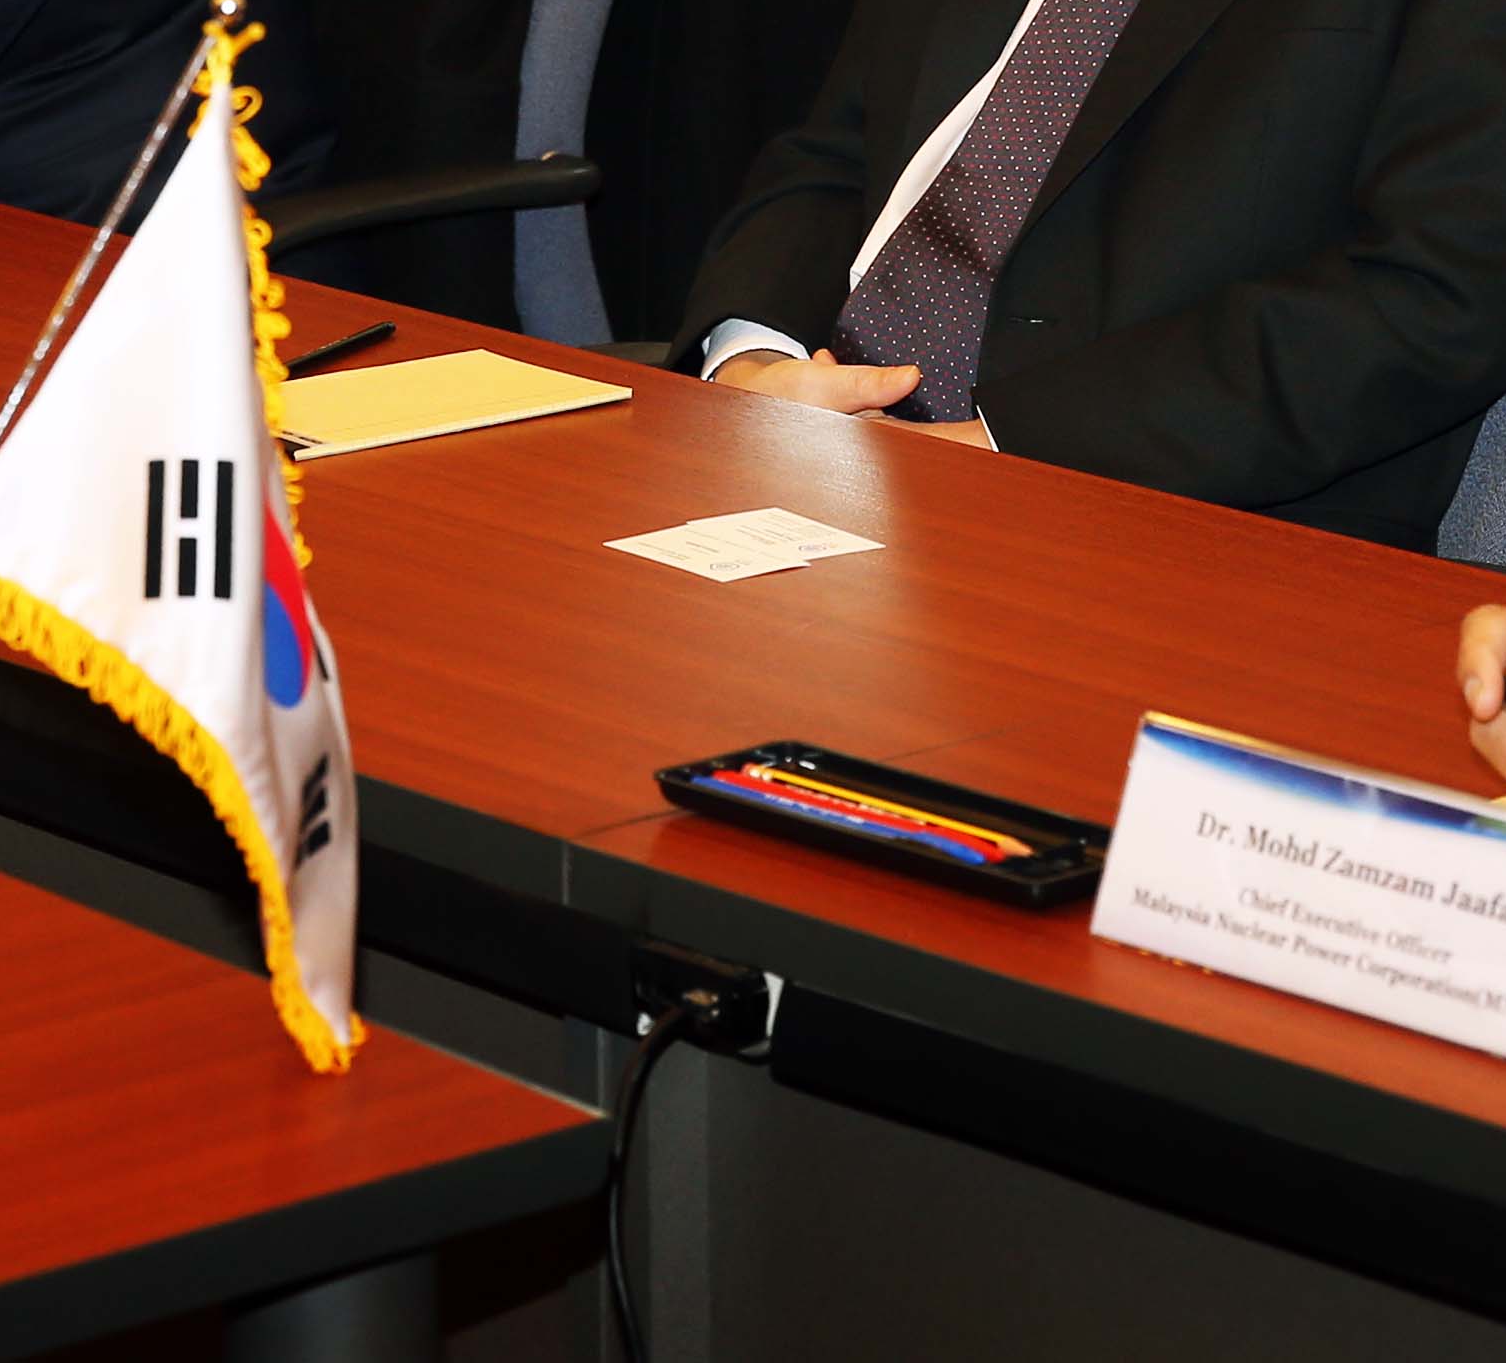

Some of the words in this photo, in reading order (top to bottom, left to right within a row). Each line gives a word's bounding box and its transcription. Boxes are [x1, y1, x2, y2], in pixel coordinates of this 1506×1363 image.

[1196, 811, 1236, 845] Dr.
[1244, 824, 1318, 867] Mohd
[1322, 846, 1436, 902] Zamzam
